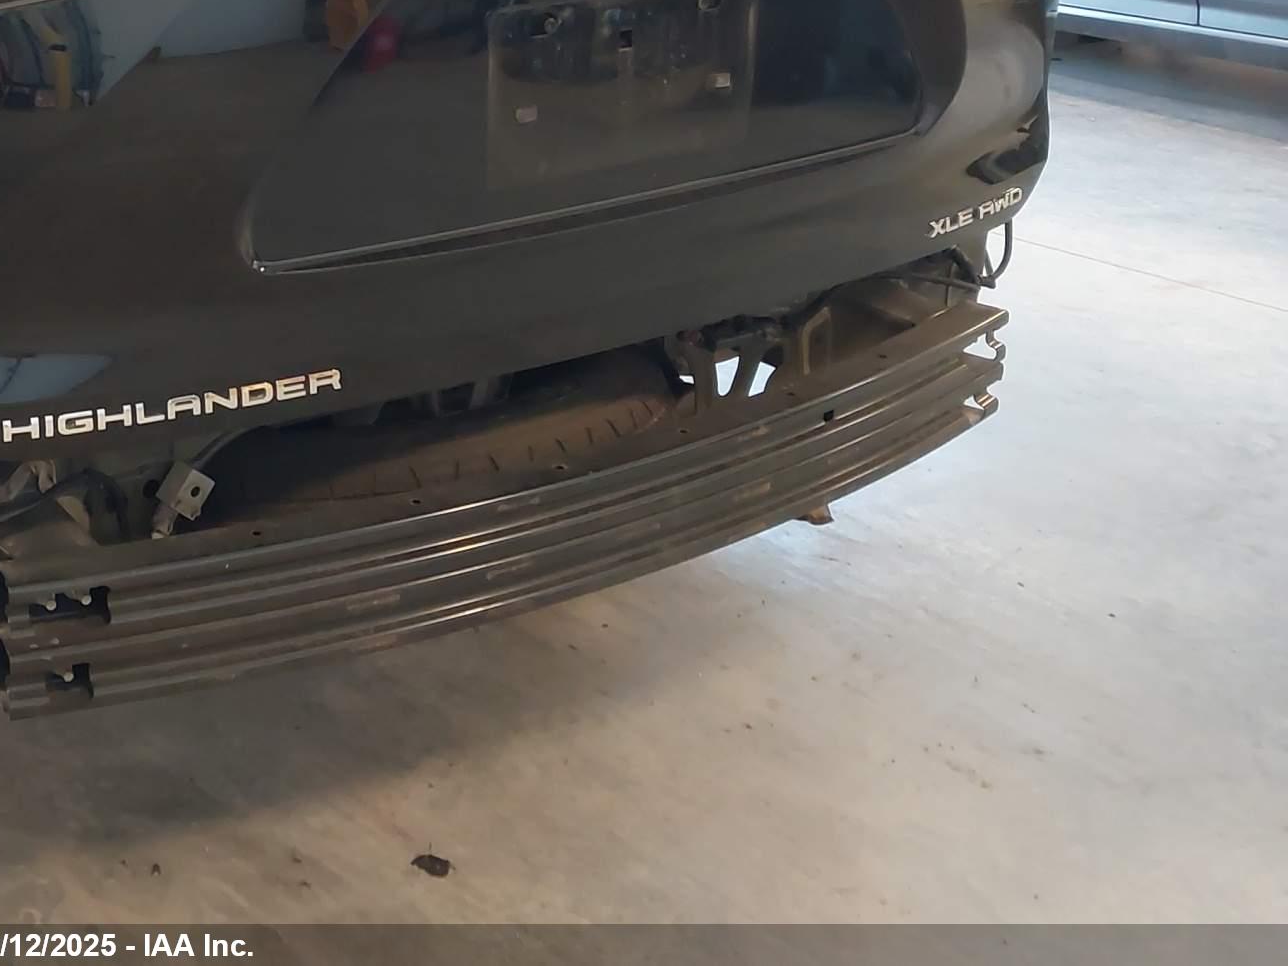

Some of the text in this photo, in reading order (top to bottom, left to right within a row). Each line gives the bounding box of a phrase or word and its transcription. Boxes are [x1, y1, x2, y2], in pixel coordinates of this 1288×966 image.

[928, 187, 1023, 238] XLE AWD
[1, 369, 343, 443] HIGHLANDER
